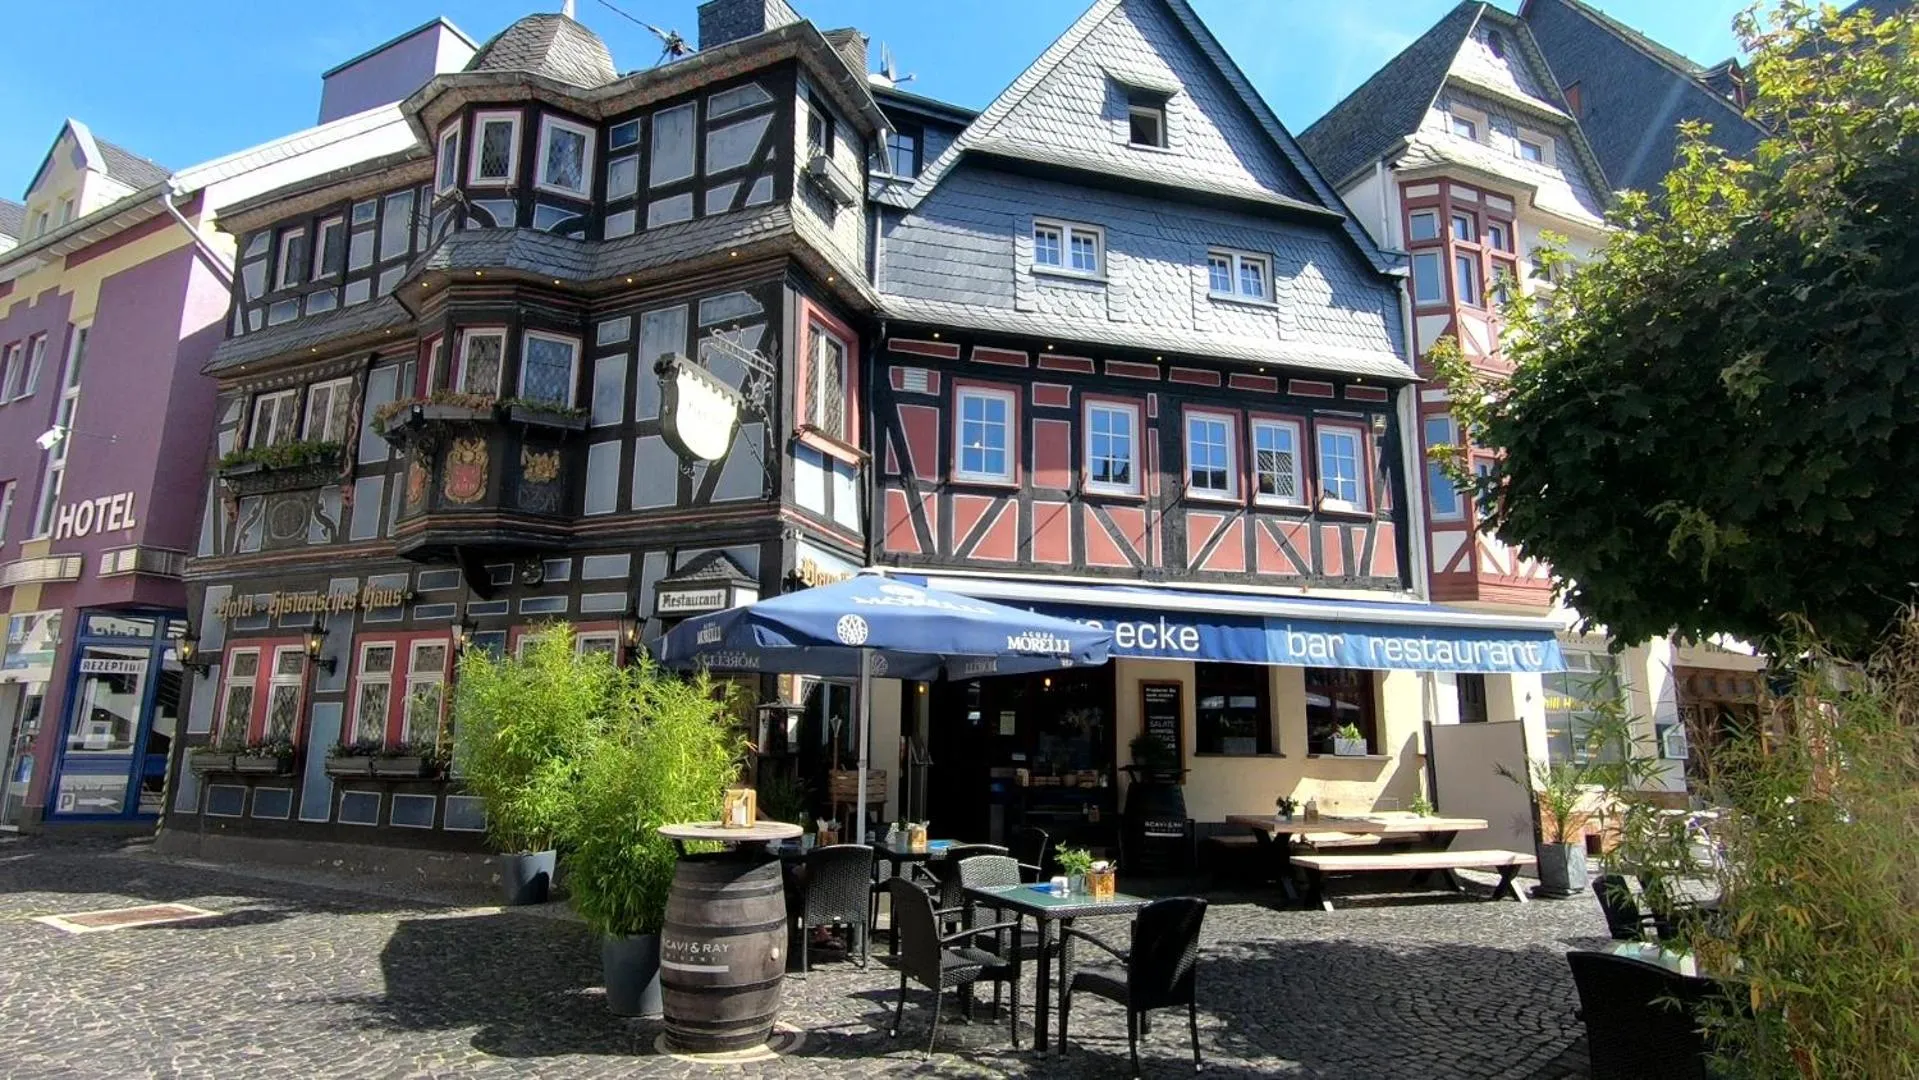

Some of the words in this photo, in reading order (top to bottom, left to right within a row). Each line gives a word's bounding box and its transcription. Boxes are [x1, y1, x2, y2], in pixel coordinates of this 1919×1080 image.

[56, 492, 135, 540] HOTEL
[218, 596, 253, 624] Hotel
[268, 588, 357, 618] Historisches
[361, 584, 402, 612] Haus
[663, 592, 723, 608] Restaurant
[1007, 635, 1070, 653] MORELLI
[1115, 615, 1200, 652] ecke
[1287, 624, 1344, 658] bar
[1369, 635, 1543, 667] restaurant
[703, 943, 729, 953] RAY
